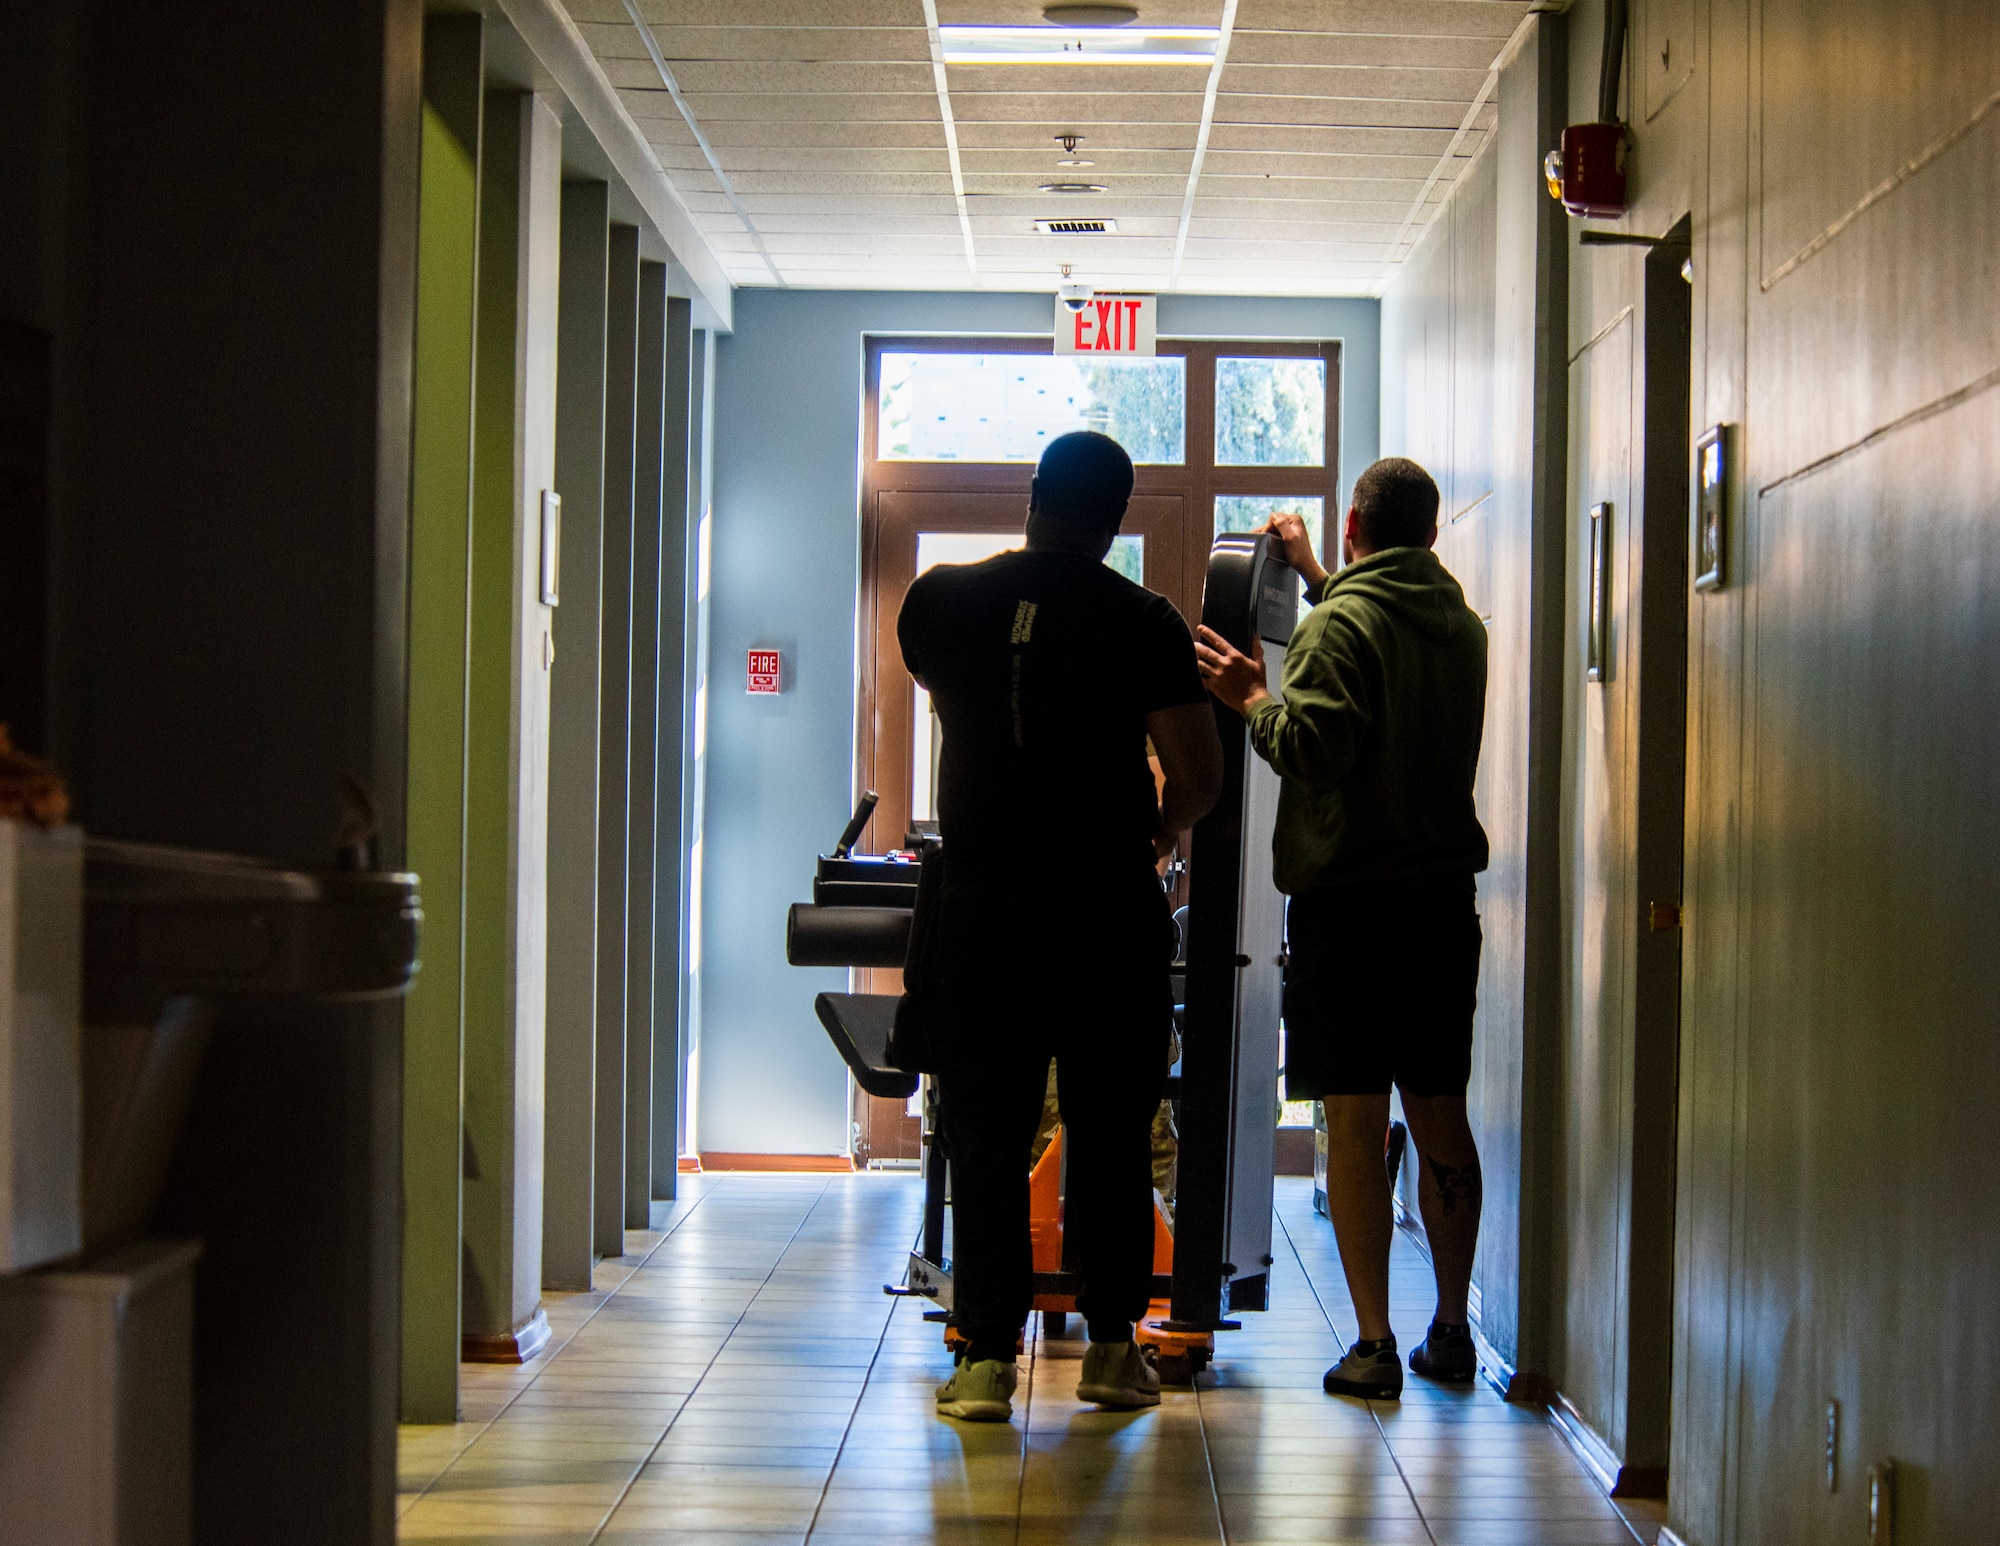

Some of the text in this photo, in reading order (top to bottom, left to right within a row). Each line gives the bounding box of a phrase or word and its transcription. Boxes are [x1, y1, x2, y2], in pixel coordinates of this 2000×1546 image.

[1577, 146, 1585, 182] FIRE
[1074, 300, 1142, 351] EXIT
[1010, 599, 1028, 645] STRENGTH
[750, 655, 776, 673] FIRE
